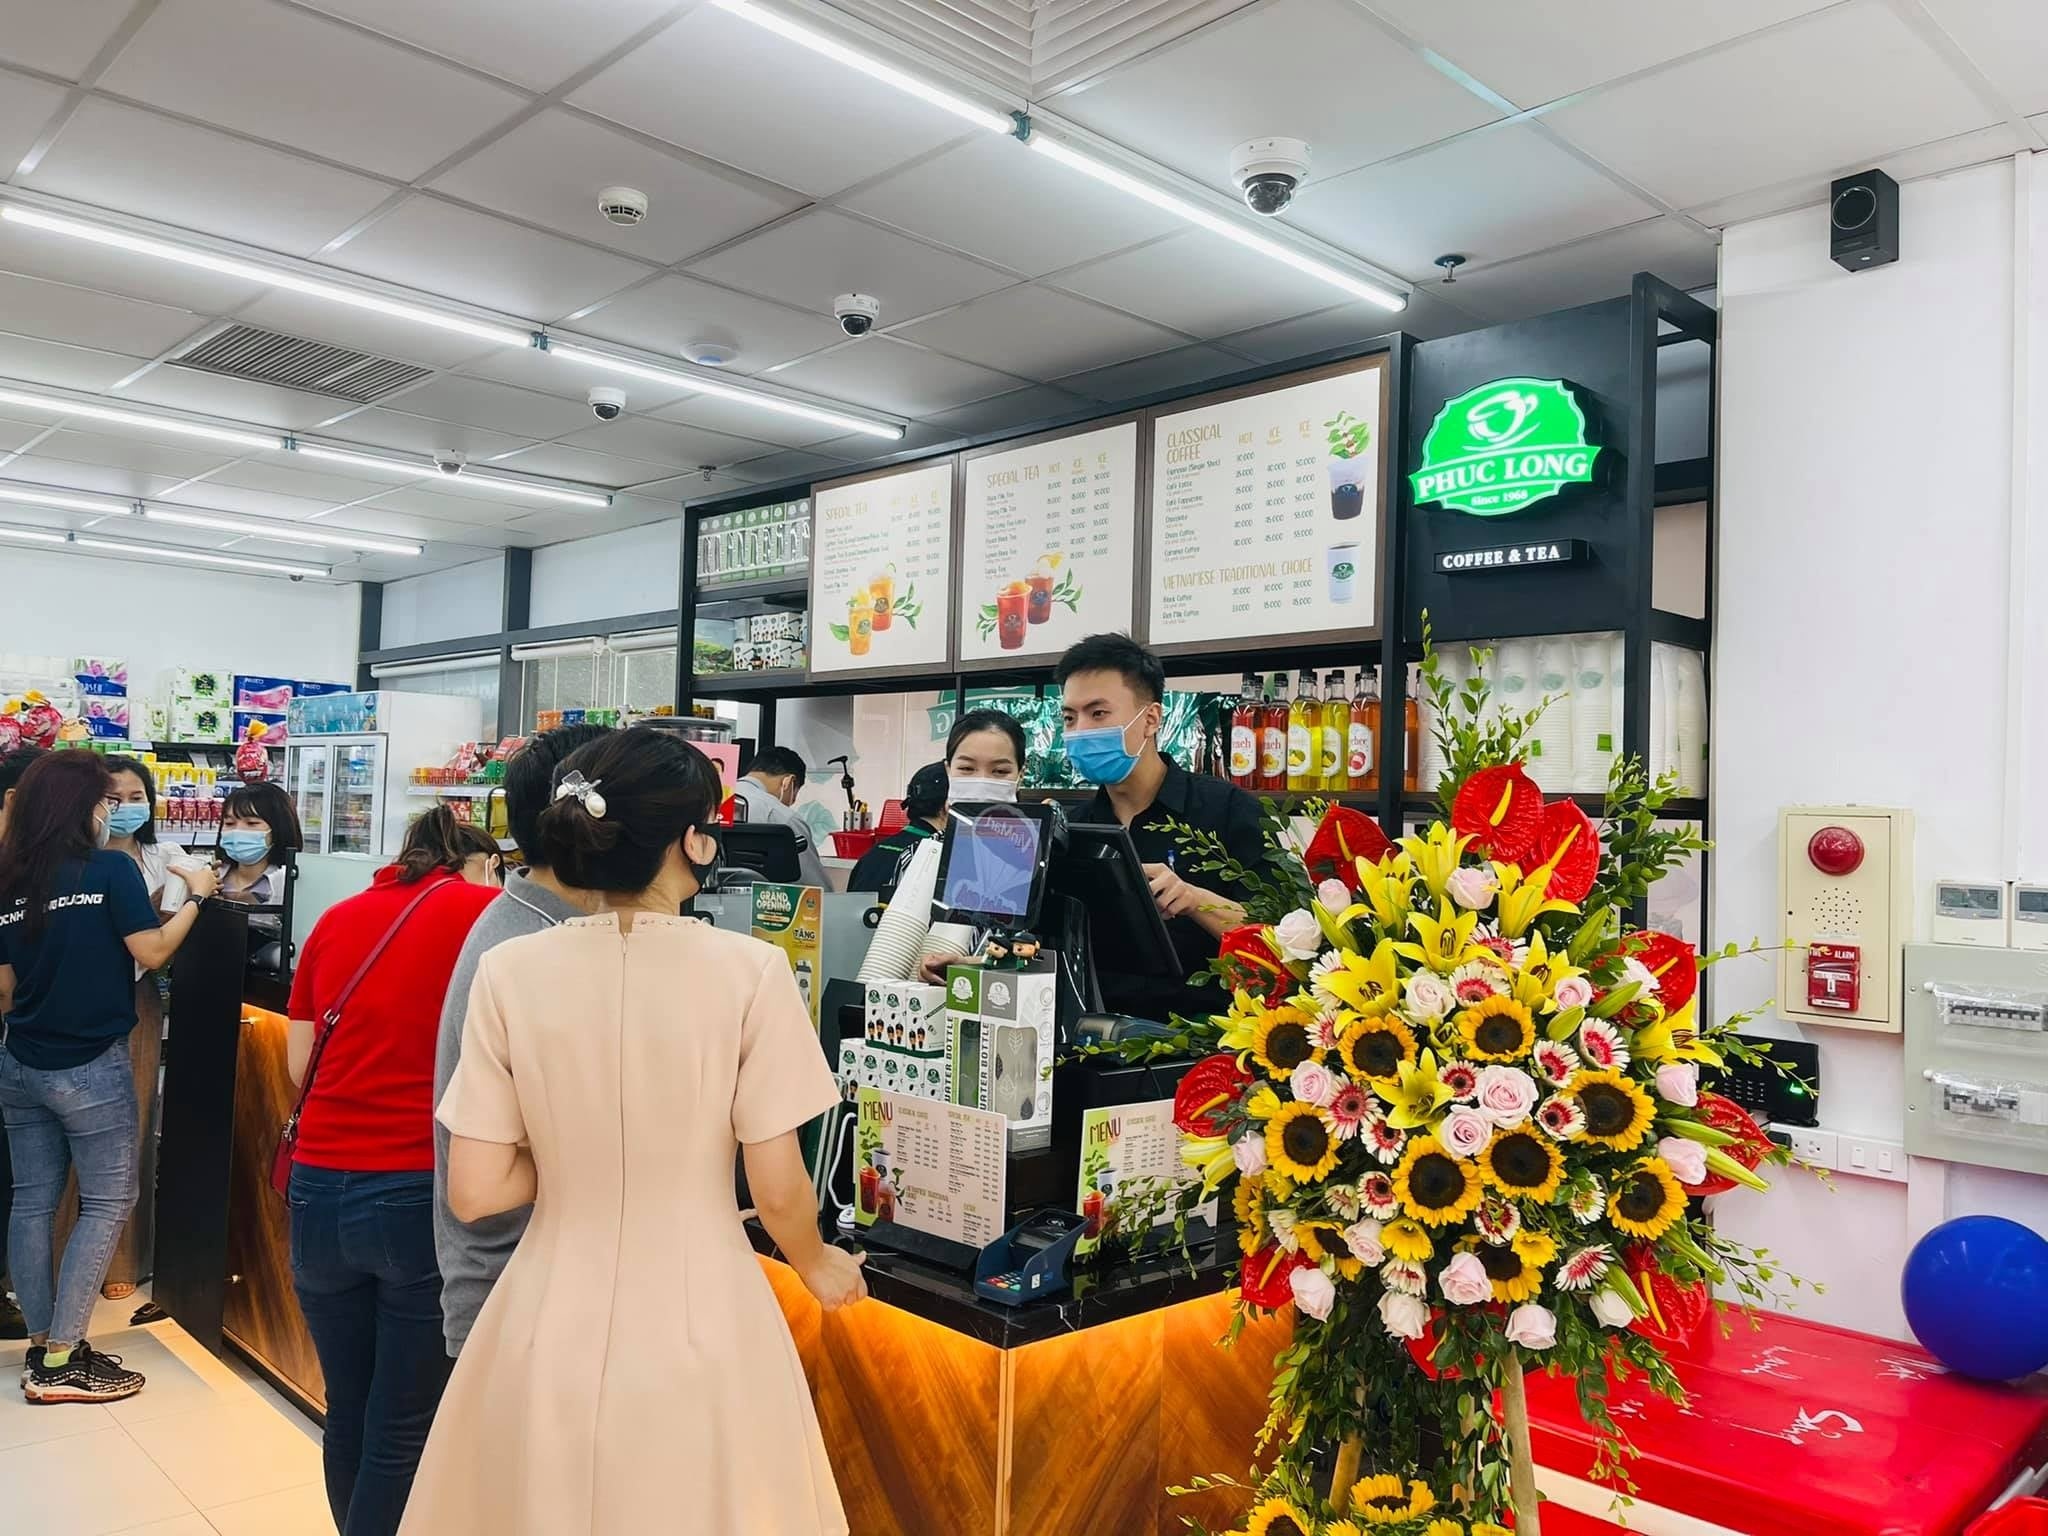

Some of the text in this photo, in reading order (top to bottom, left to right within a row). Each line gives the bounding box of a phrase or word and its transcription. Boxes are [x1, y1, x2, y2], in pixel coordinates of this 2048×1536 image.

[1167, 423, 1223, 448] CLASSICAL
[1167, 443, 1200, 464] COFFEE
[1023, 464, 1040, 480] TEA
[1417, 453, 1589, 499] PHUC LONG
[1471, 494, 1500, 506] Since
[1442, 545, 1560, 569] COFFEE & TEA
[1162, 557, 1313, 591] VIETNAMESE TRADITIONAL CHOICE
[756, 898, 792, 913] OPENING
[760, 890, 789, 902] GRAND
[1834, 950, 1855, 960] ALARM
[981, 1023, 990, 1068] BOTTLE
[863, 1101, 893, 1121] MENU
[1089, 1117, 1121, 1145] MENU
